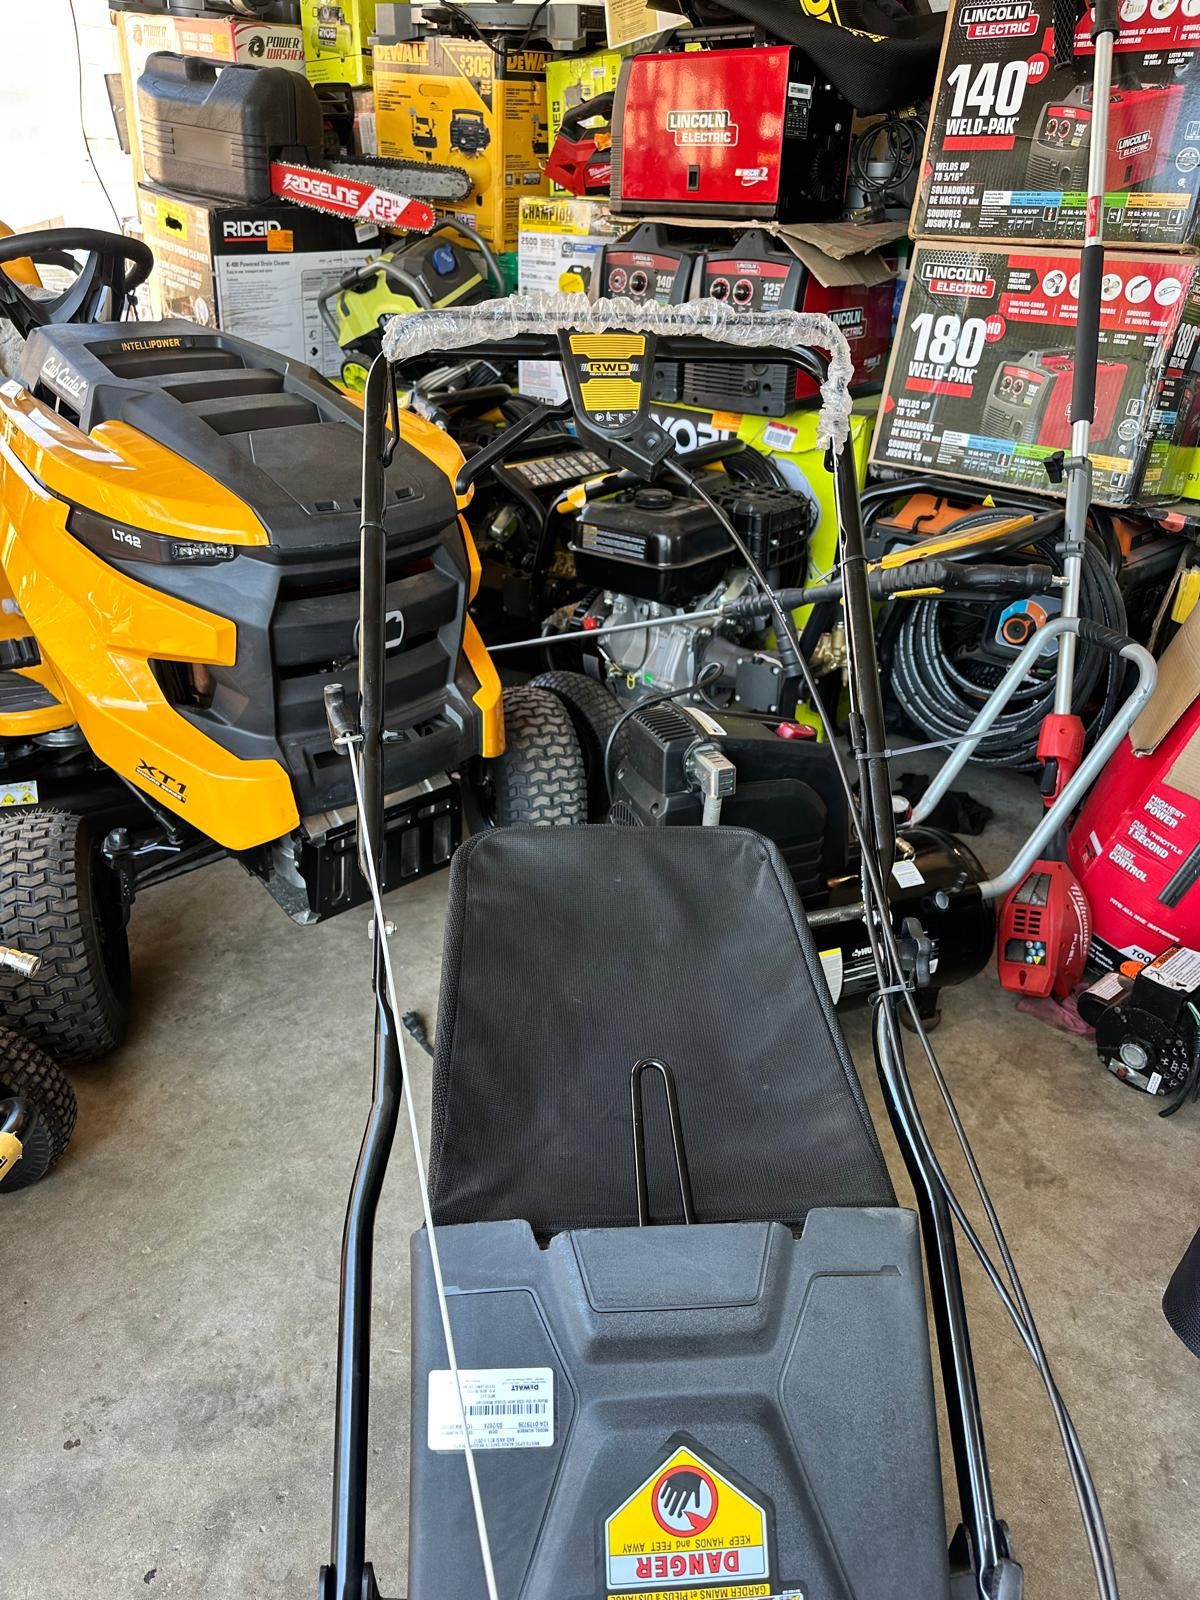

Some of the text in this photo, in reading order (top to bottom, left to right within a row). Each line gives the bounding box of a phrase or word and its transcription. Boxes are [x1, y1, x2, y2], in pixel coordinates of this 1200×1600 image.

[963, 6, 1027, 23] LINCOLN
[975, 22, 1030, 36] ELECTRIC
[266, 36, 300, 49] POWER
[266, 48, 305, 61] WASHER
[375, 43, 429, 62] DEWALT
[460, 55, 491, 78] $305
[506, 51, 552, 72] DEWA
[947, 61, 1044, 117] 140 HD
[670, 113, 726, 129] LINCOLN
[945, 118, 1015, 135] WELD-PAK
[682, 132, 731, 143] ELECTRIC
[1119, 133, 1148, 149] LINCOLN
[1123, 143, 1149, 156] ELECTRIC
[935, 162, 969, 171] WELDS UP
[934, 173, 963, 182] TO 5/16"
[282, 173, 361, 206] RIDGELINE
[931, 186, 975, 195] SOLDADURAS
[929, 196, 939, 204] DE
[940, 196, 961, 205] HASTA
[962, 197, 967, 205] 8
[927, 209, 961, 218] SOUDURES
[223, 220, 281, 238] RIDGID
[953, 219, 959, 228] 8
[925, 265, 984, 281] LINCOLN
[656, 275, 671, 288] 140
[763, 283, 780, 296] 125
[937, 282, 987, 295] ELECTRIC
[842, 326, 863, 337] ECTRIC
[121, 338, 181, 351] INTELLIPOWER
[910, 313, 1001, 367] 180 HD
[1173, 323, 1197, 358] 180
[590, 363, 630, 372] RWD
[908, 361, 973, 384] WELD-PAK
[42, 357, 87, 398] Cub Cadet
[896, 407, 920, 417] TO 1/2"
[898, 398, 931, 410] WELDS UP
[893, 419, 934, 432] SOLDADURAS
[891, 428, 900, 436] DE
[900, 429, 920, 439] HASTA
[922, 433, 931, 441] 13
[888, 439, 921, 451] SOUDURES
[111, 528, 142, 549] LT42
[139, 759, 187, 794] XT1
[1144, 801, 1178, 828] POWER
[1151, 794, 1187, 820] HIGHEST
[1132, 819, 1184, 855] FULL THROTTLE
[1115, 844, 1136, 860] BEST
[1108, 852, 1148, 883] CONTROL
[1070, 883, 1090, 956] Milwaukee
[1066, 933, 1078, 966] FUEL
[1131, 949, 1153, 965] TOO
[622, 1535, 751, 1554] KEEP HANDS and FEET AWAY
[636, 1550, 740, 1579] DANGER
[663, 1589, 688, 1600] PIEDS
[690, 1589, 699, 1599] et
[700, 1587, 728, 1599] MAINS
[731, 1585, 767, 1598] GARDER
